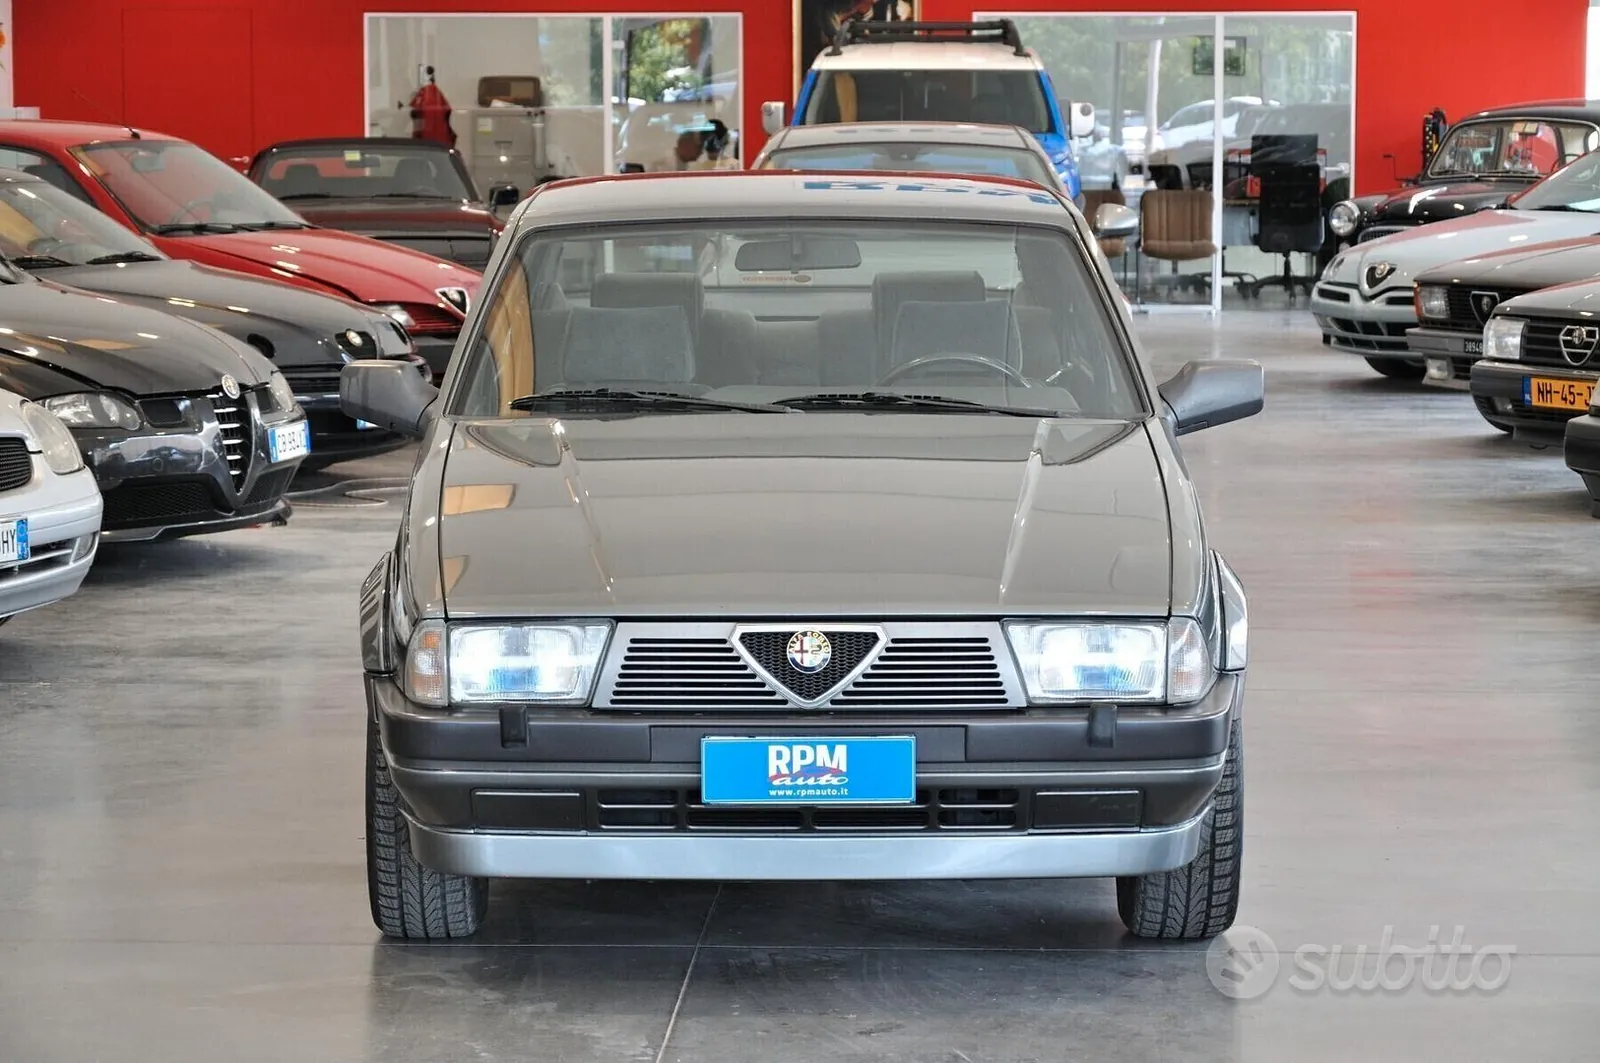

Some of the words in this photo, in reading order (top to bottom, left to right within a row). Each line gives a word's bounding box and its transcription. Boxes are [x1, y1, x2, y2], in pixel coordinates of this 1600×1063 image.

[1537, 382, 1595, 406] NH-45-J
[0, 529, 16, 554] HY
[768, 744, 847, 778] RPM
[772, 772, 849, 786] auto
[768, 787, 849, 797] www.rpmauto.it
